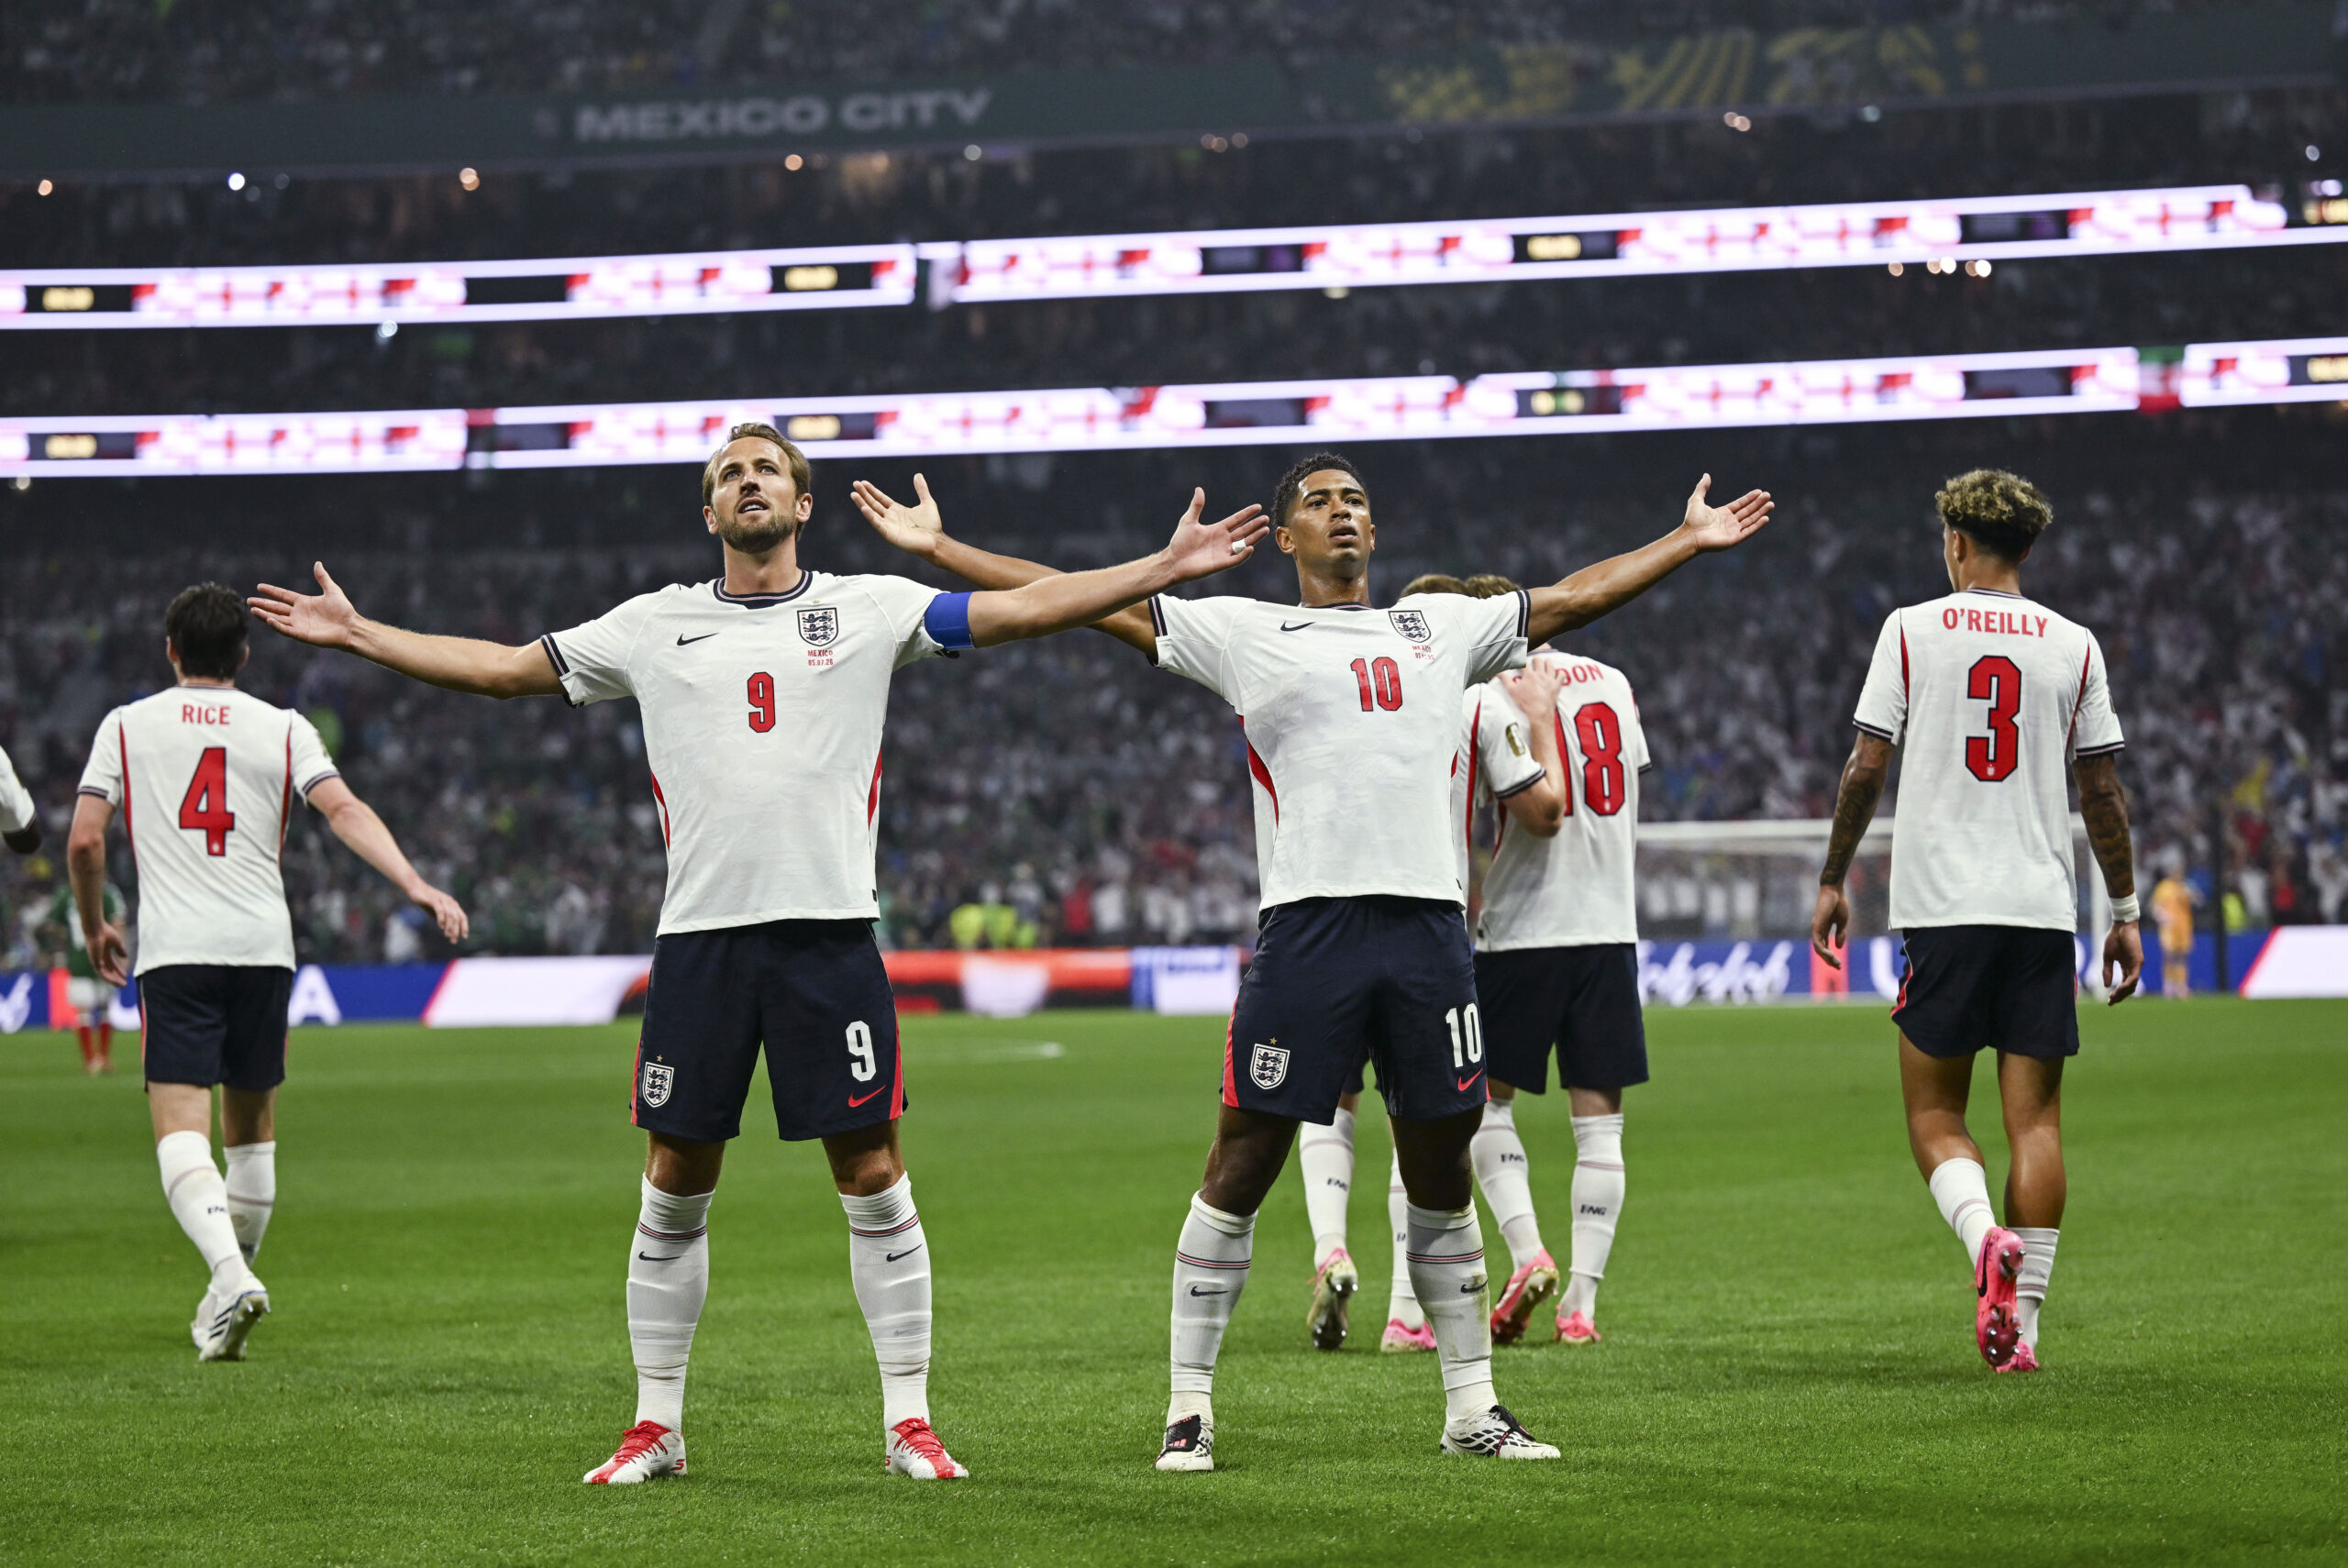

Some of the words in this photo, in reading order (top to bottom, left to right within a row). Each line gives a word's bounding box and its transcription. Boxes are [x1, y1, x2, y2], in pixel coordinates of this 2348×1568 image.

[575, 97, 825, 141] MEXICO
[836, 90, 990, 130] CITY
[1943, 608, 2048, 638] O'REILLY
[808, 658, 834, 667] 05.07.26
[1350, 657, 1402, 712] 10
[182, 703, 231, 725] RICE
[748, 671, 776, 734] 9
[1966, 655, 2021, 782] 3
[179, 746, 235, 857] 4
[846, 1020, 877, 1082] 9
[1445, 1002, 1482, 1068] 10
[1580, 1204, 1607, 1216] ENG
